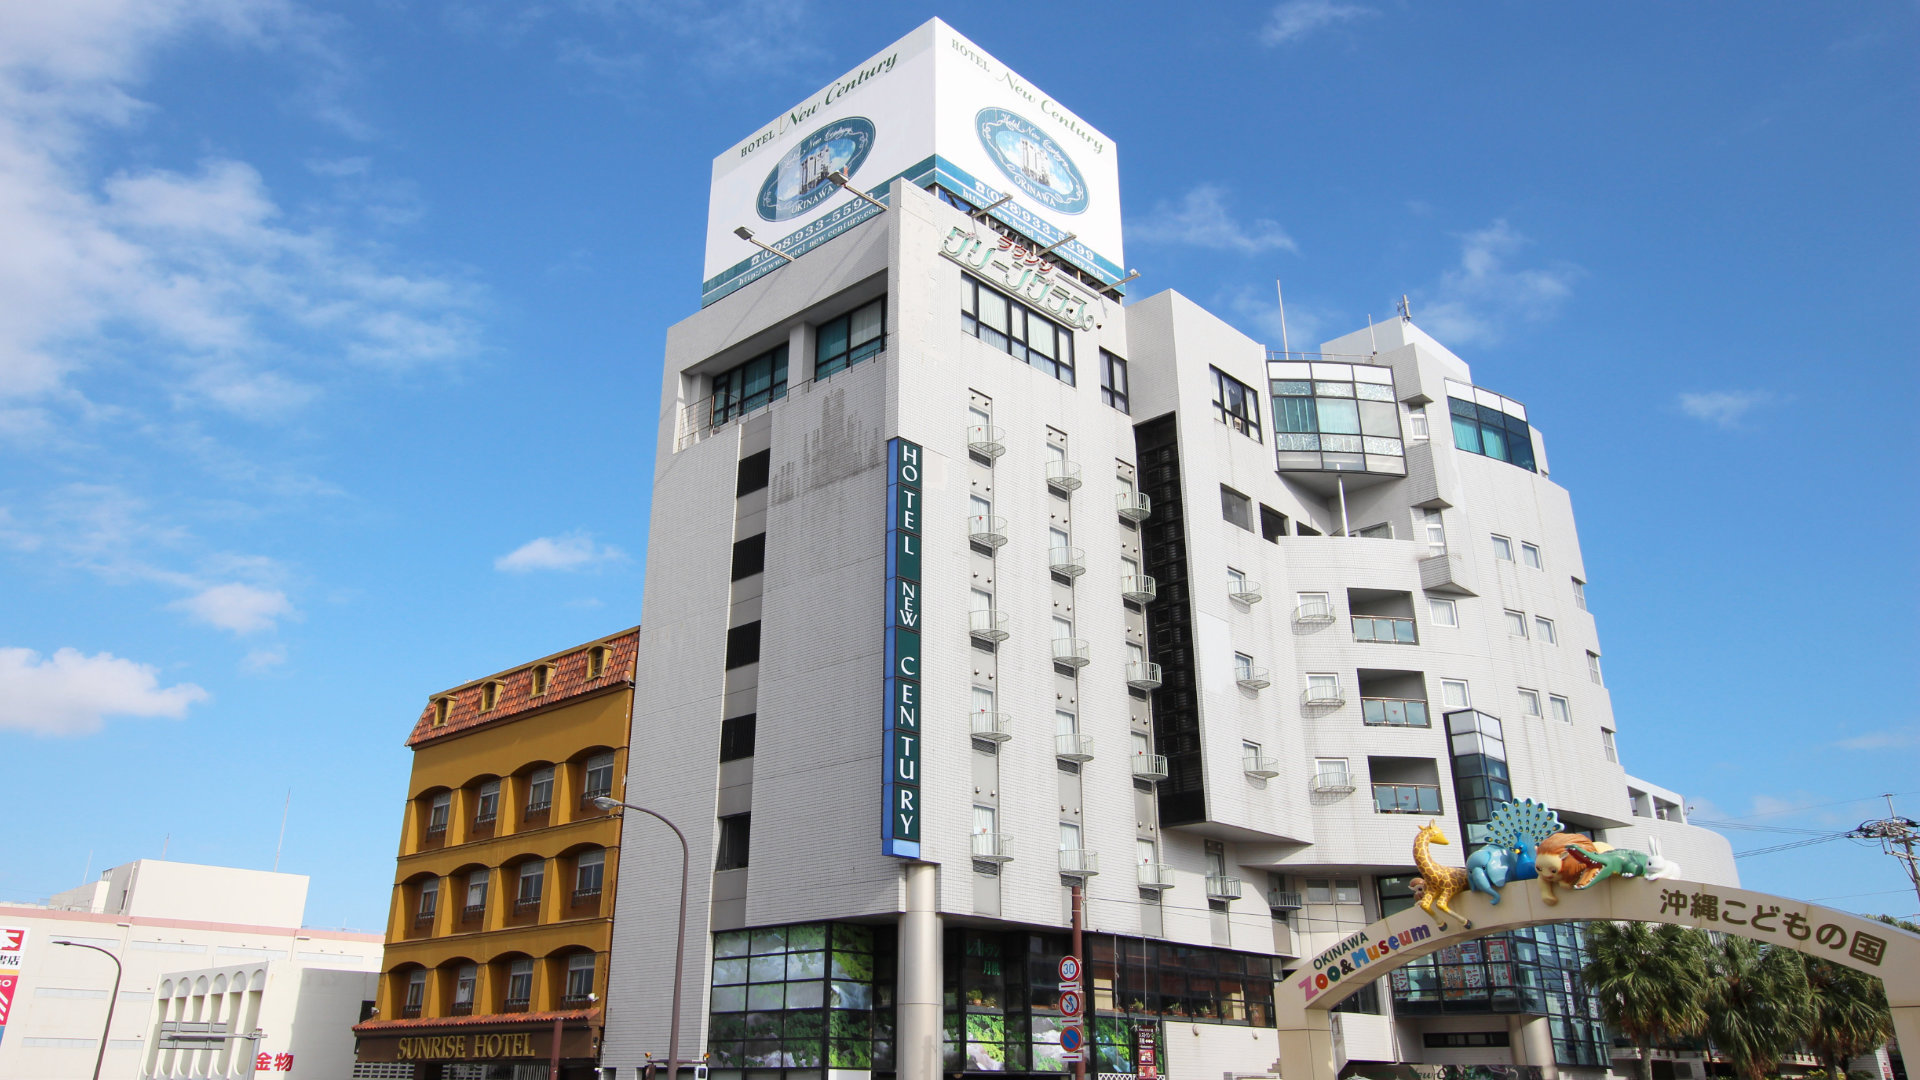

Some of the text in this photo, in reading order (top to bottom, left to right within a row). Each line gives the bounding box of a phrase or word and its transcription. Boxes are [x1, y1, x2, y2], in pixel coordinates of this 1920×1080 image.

[741, 52, 898, 158] HOTEL New Century
[952, 38, 1104, 154] HOTEL New Century
[791, 185, 835, 214] OKINAWA
[1014, 174, 1057, 207] OKINAWA
[997, 235, 1054, 274] ラウンジ
[899, 444, 918, 835] HOTEL NEW CENTURY
[1660, 888, 1888, 967] 沖縄こどもの国
[1062, 962, 1075, 975] 30
[1313, 931, 1369, 970] OKINAWA
[255, 1052, 294, 1072] 金物
[397, 1032, 536, 1060] SUNRISE HOTEL
